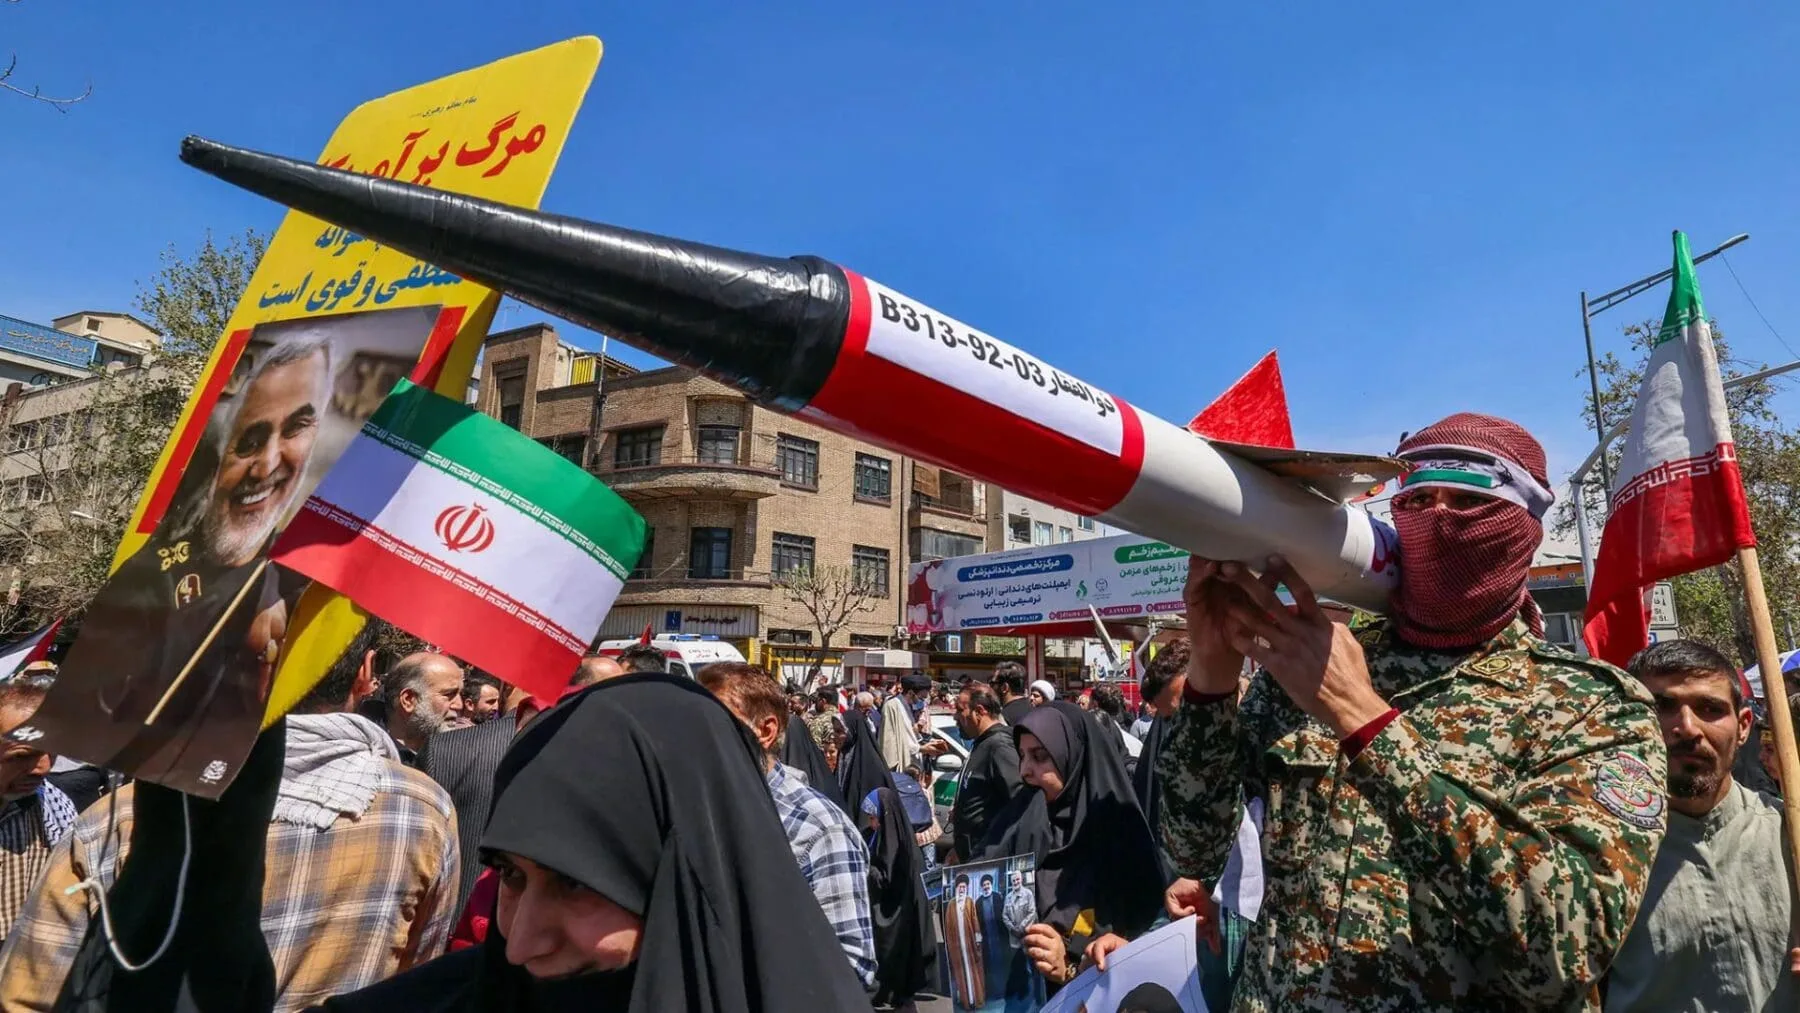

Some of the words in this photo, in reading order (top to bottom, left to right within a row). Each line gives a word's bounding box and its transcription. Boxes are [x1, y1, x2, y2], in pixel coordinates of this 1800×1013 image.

[455, 110, 546, 178] مرگ
[411, 140, 450, 186] بر
[258, 271, 313, 309] است
[305, 261, 366, 312] قوی
[352, 275, 376, 308] و
[878, 292, 1046, 388] B313-92-03
[968, 565, 1011, 580] دندانپزشکی
[1010, 560, 1040, 575] تخصصی
[1039, 558, 1061, 572] مرکز
[958, 584, 994, 600] ارتودنسی
